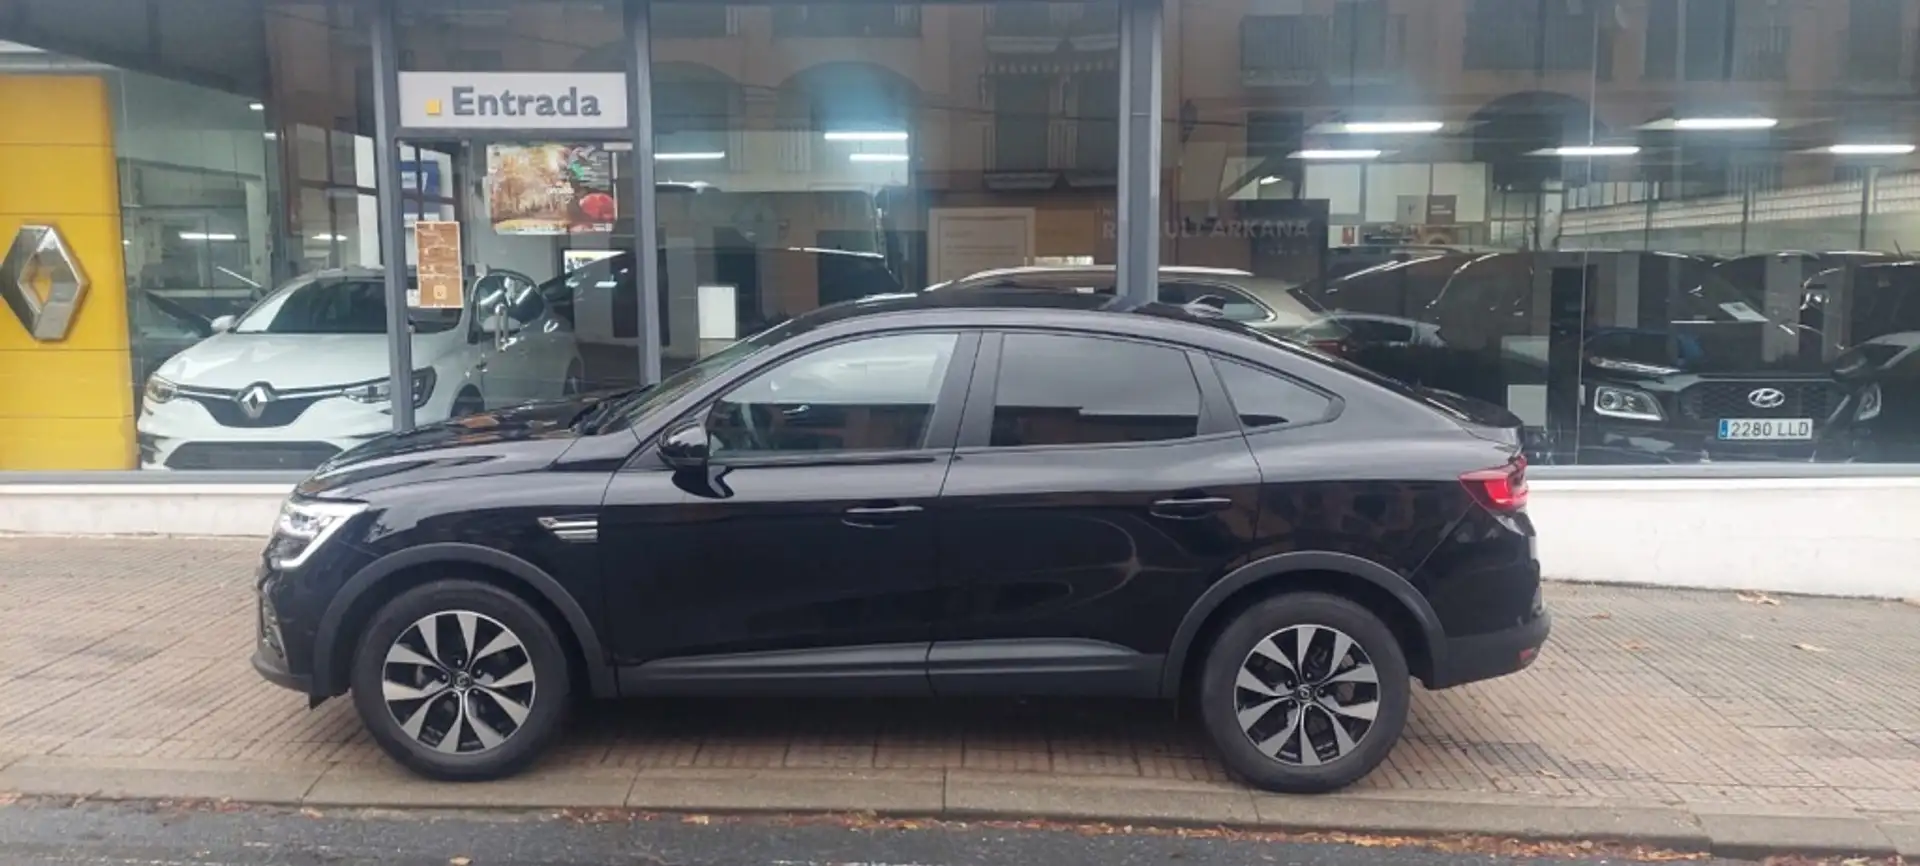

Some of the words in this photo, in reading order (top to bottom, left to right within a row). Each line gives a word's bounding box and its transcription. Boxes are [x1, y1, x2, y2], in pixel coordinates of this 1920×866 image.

[452, 86, 601, 116] Entrada
[1102, 221, 1202, 240] RULT
[1209, 219, 1310, 239] ARKANA
[1731, 422, 1773, 437] 2280
[1777, 422, 1809, 437] LLD
